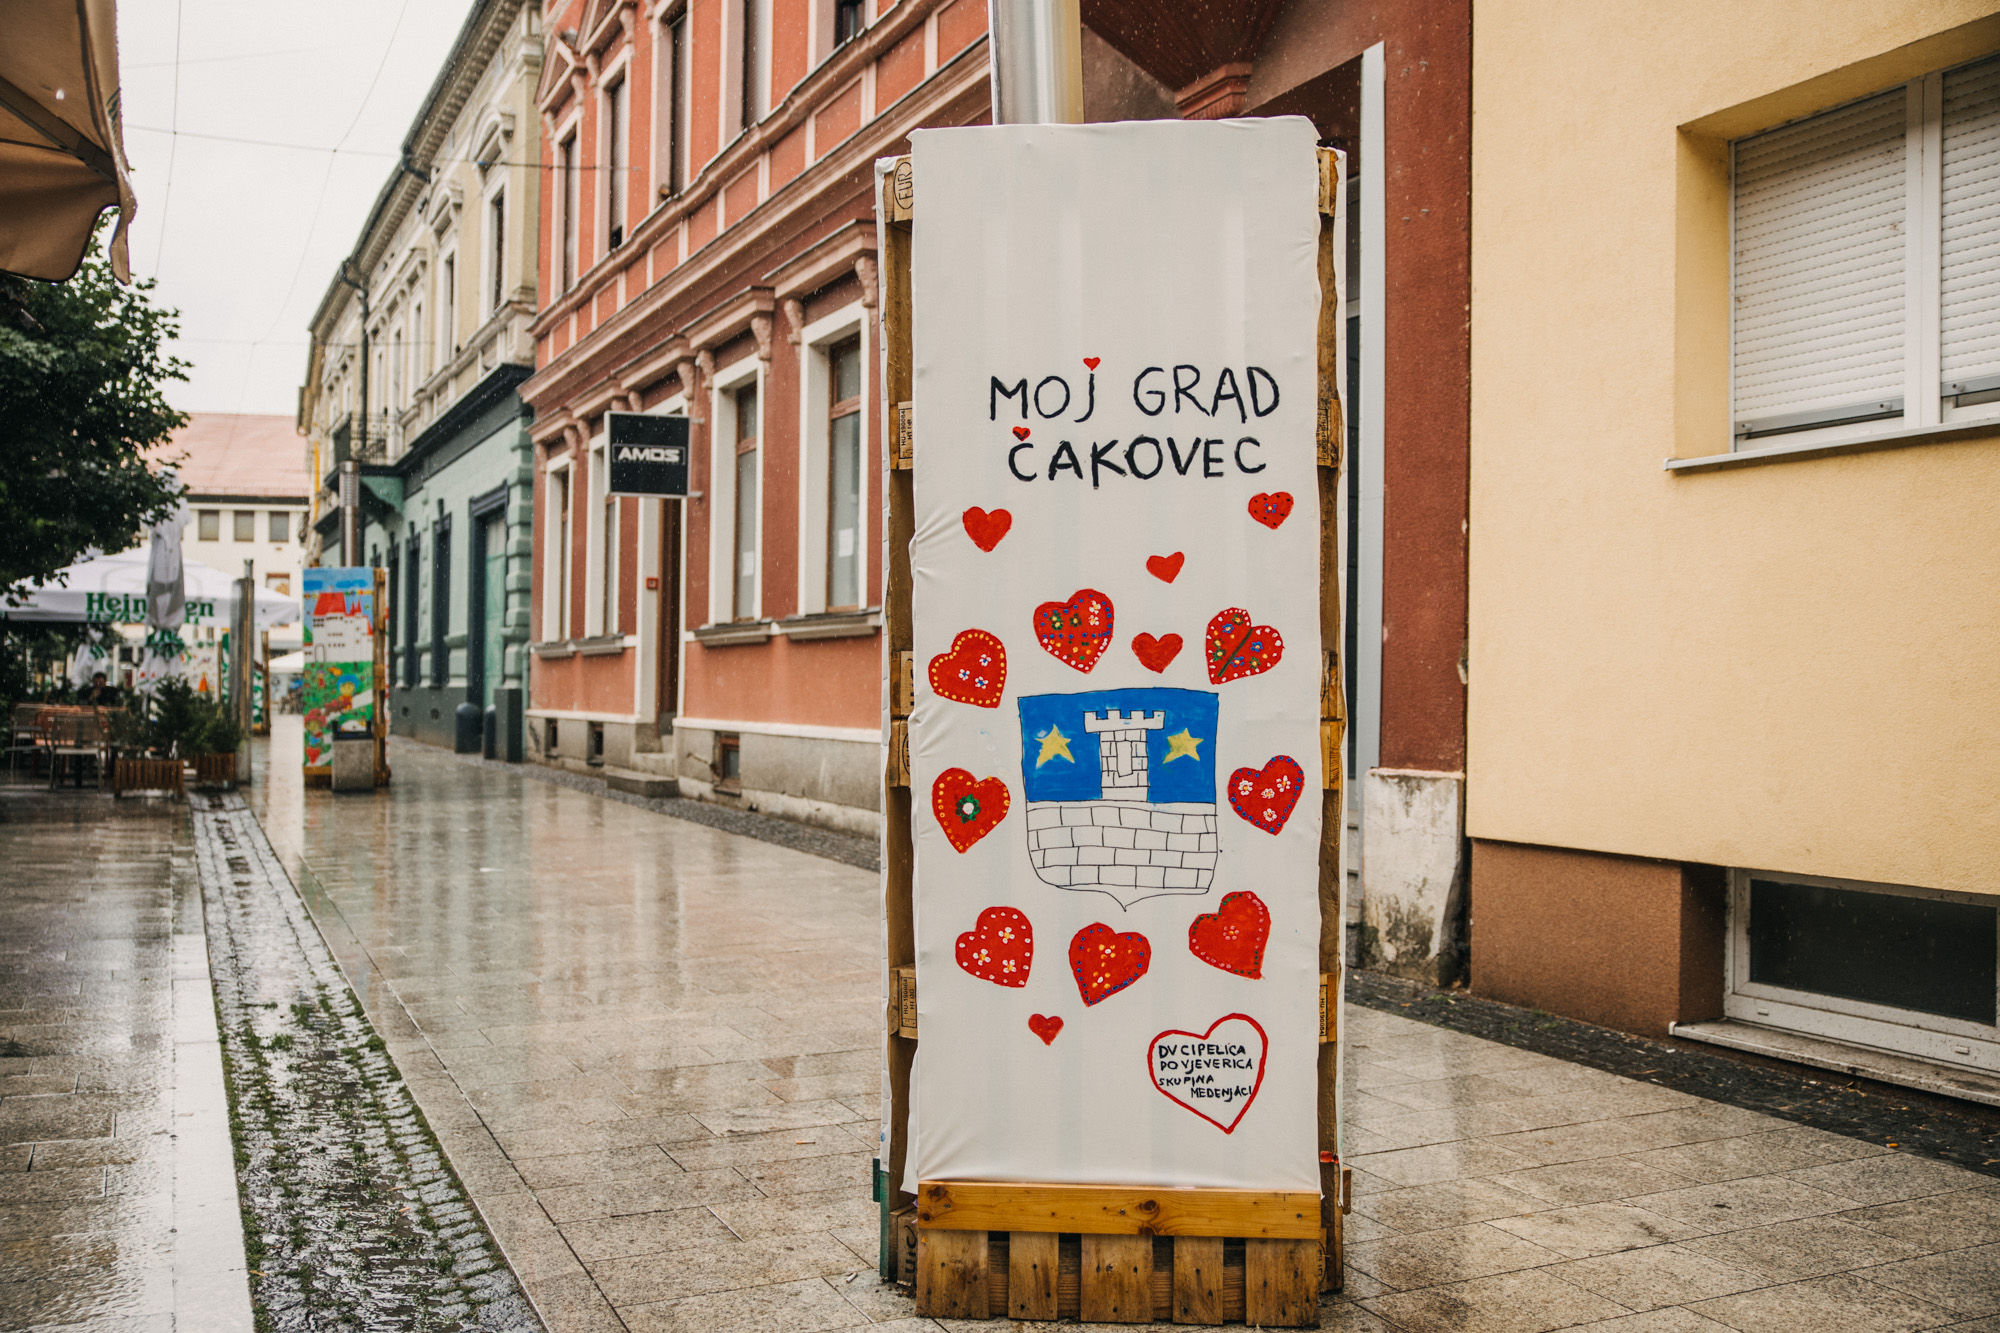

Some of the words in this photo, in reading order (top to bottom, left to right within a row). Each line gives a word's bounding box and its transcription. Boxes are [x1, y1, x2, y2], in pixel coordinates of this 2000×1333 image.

[898, 171, 914, 200] EUR
[990, 368, 1096, 423] MOJ
[1133, 364, 1280, 424] GRAD
[618, 446, 680, 463] AMOS
[1008, 427, 1267, 490] ČAKOVEC
[85, 592, 215, 618] Heinen
[1158, 1074, 1214, 1087] SKUPINA
[1190, 1085, 1252, 1102] MEDENJACI
